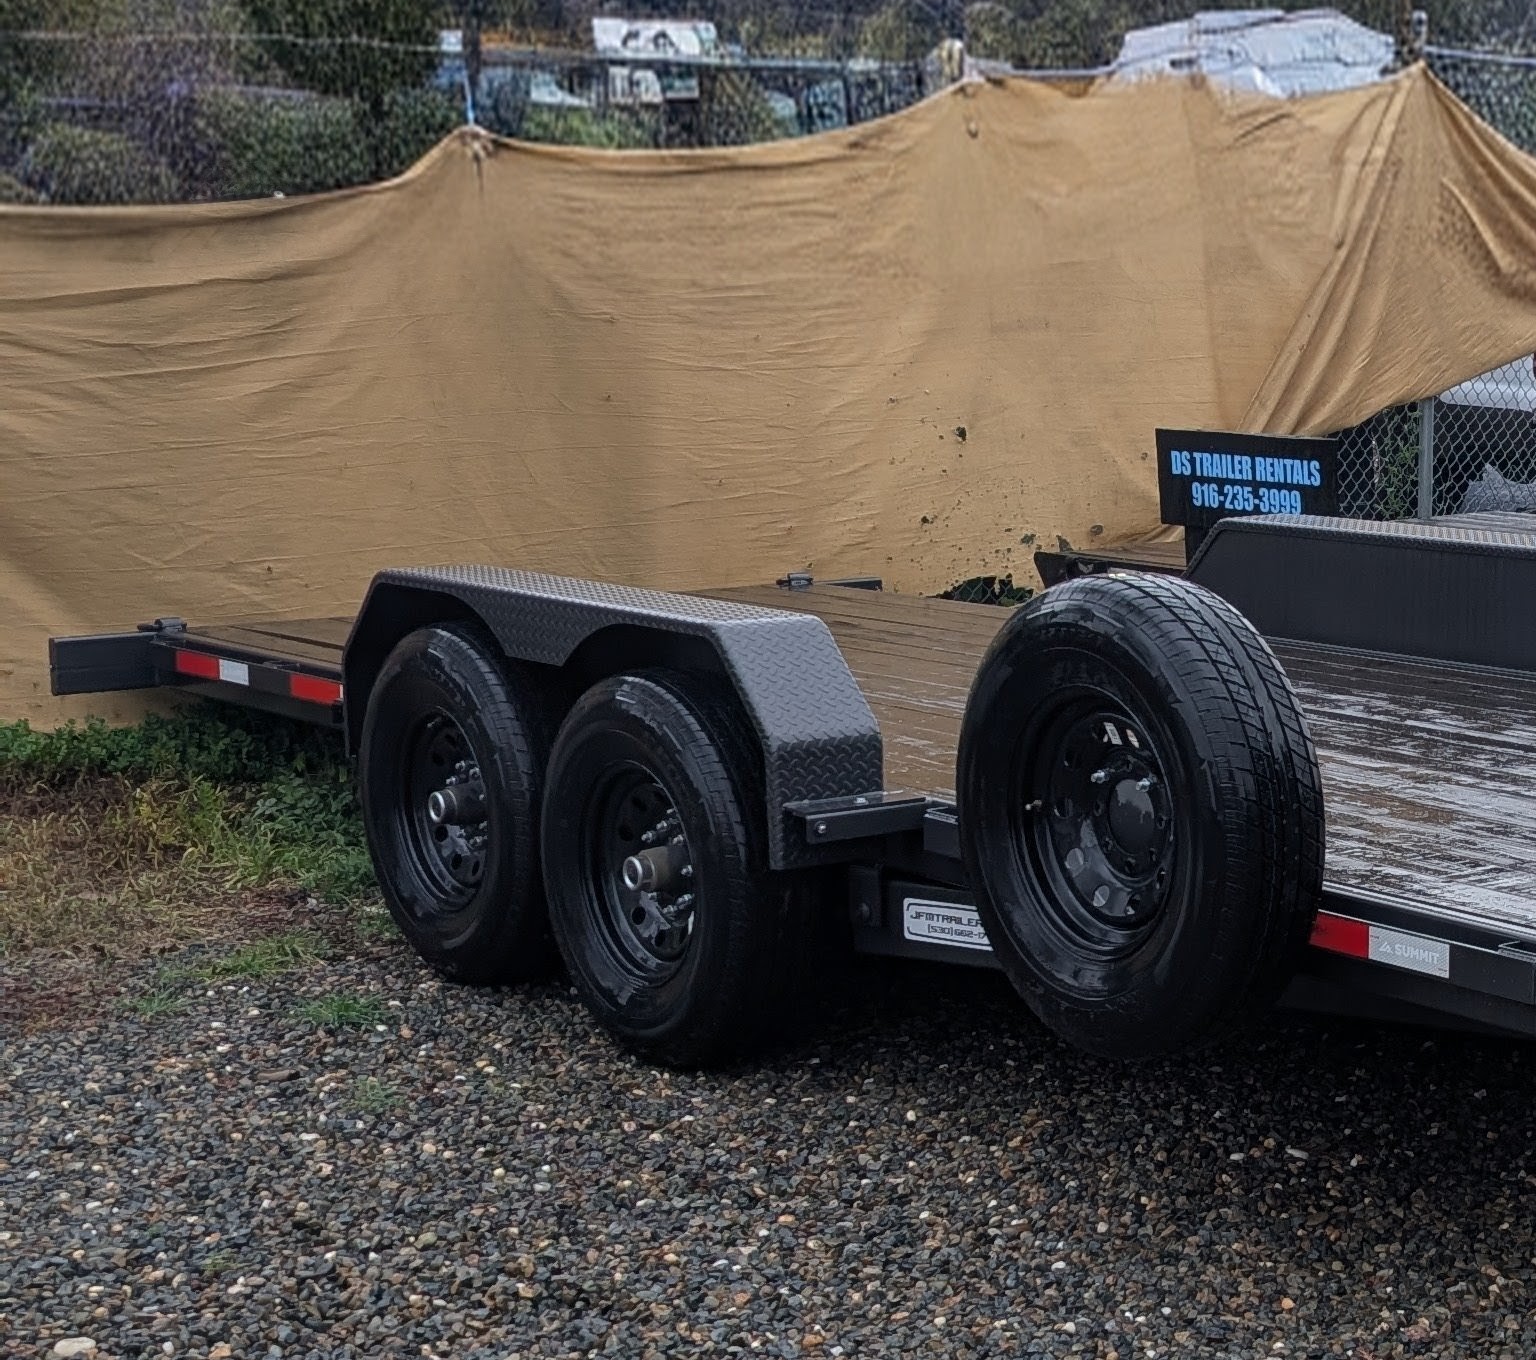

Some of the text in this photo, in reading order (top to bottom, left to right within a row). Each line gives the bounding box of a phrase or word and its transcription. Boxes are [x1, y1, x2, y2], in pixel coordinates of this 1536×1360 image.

[1170, 450, 1321, 487] DS TRAILER RENTALS
[1191, 481, 1302, 515] 916-235-3999
[1394, 943, 1440, 965] SUMMIT
